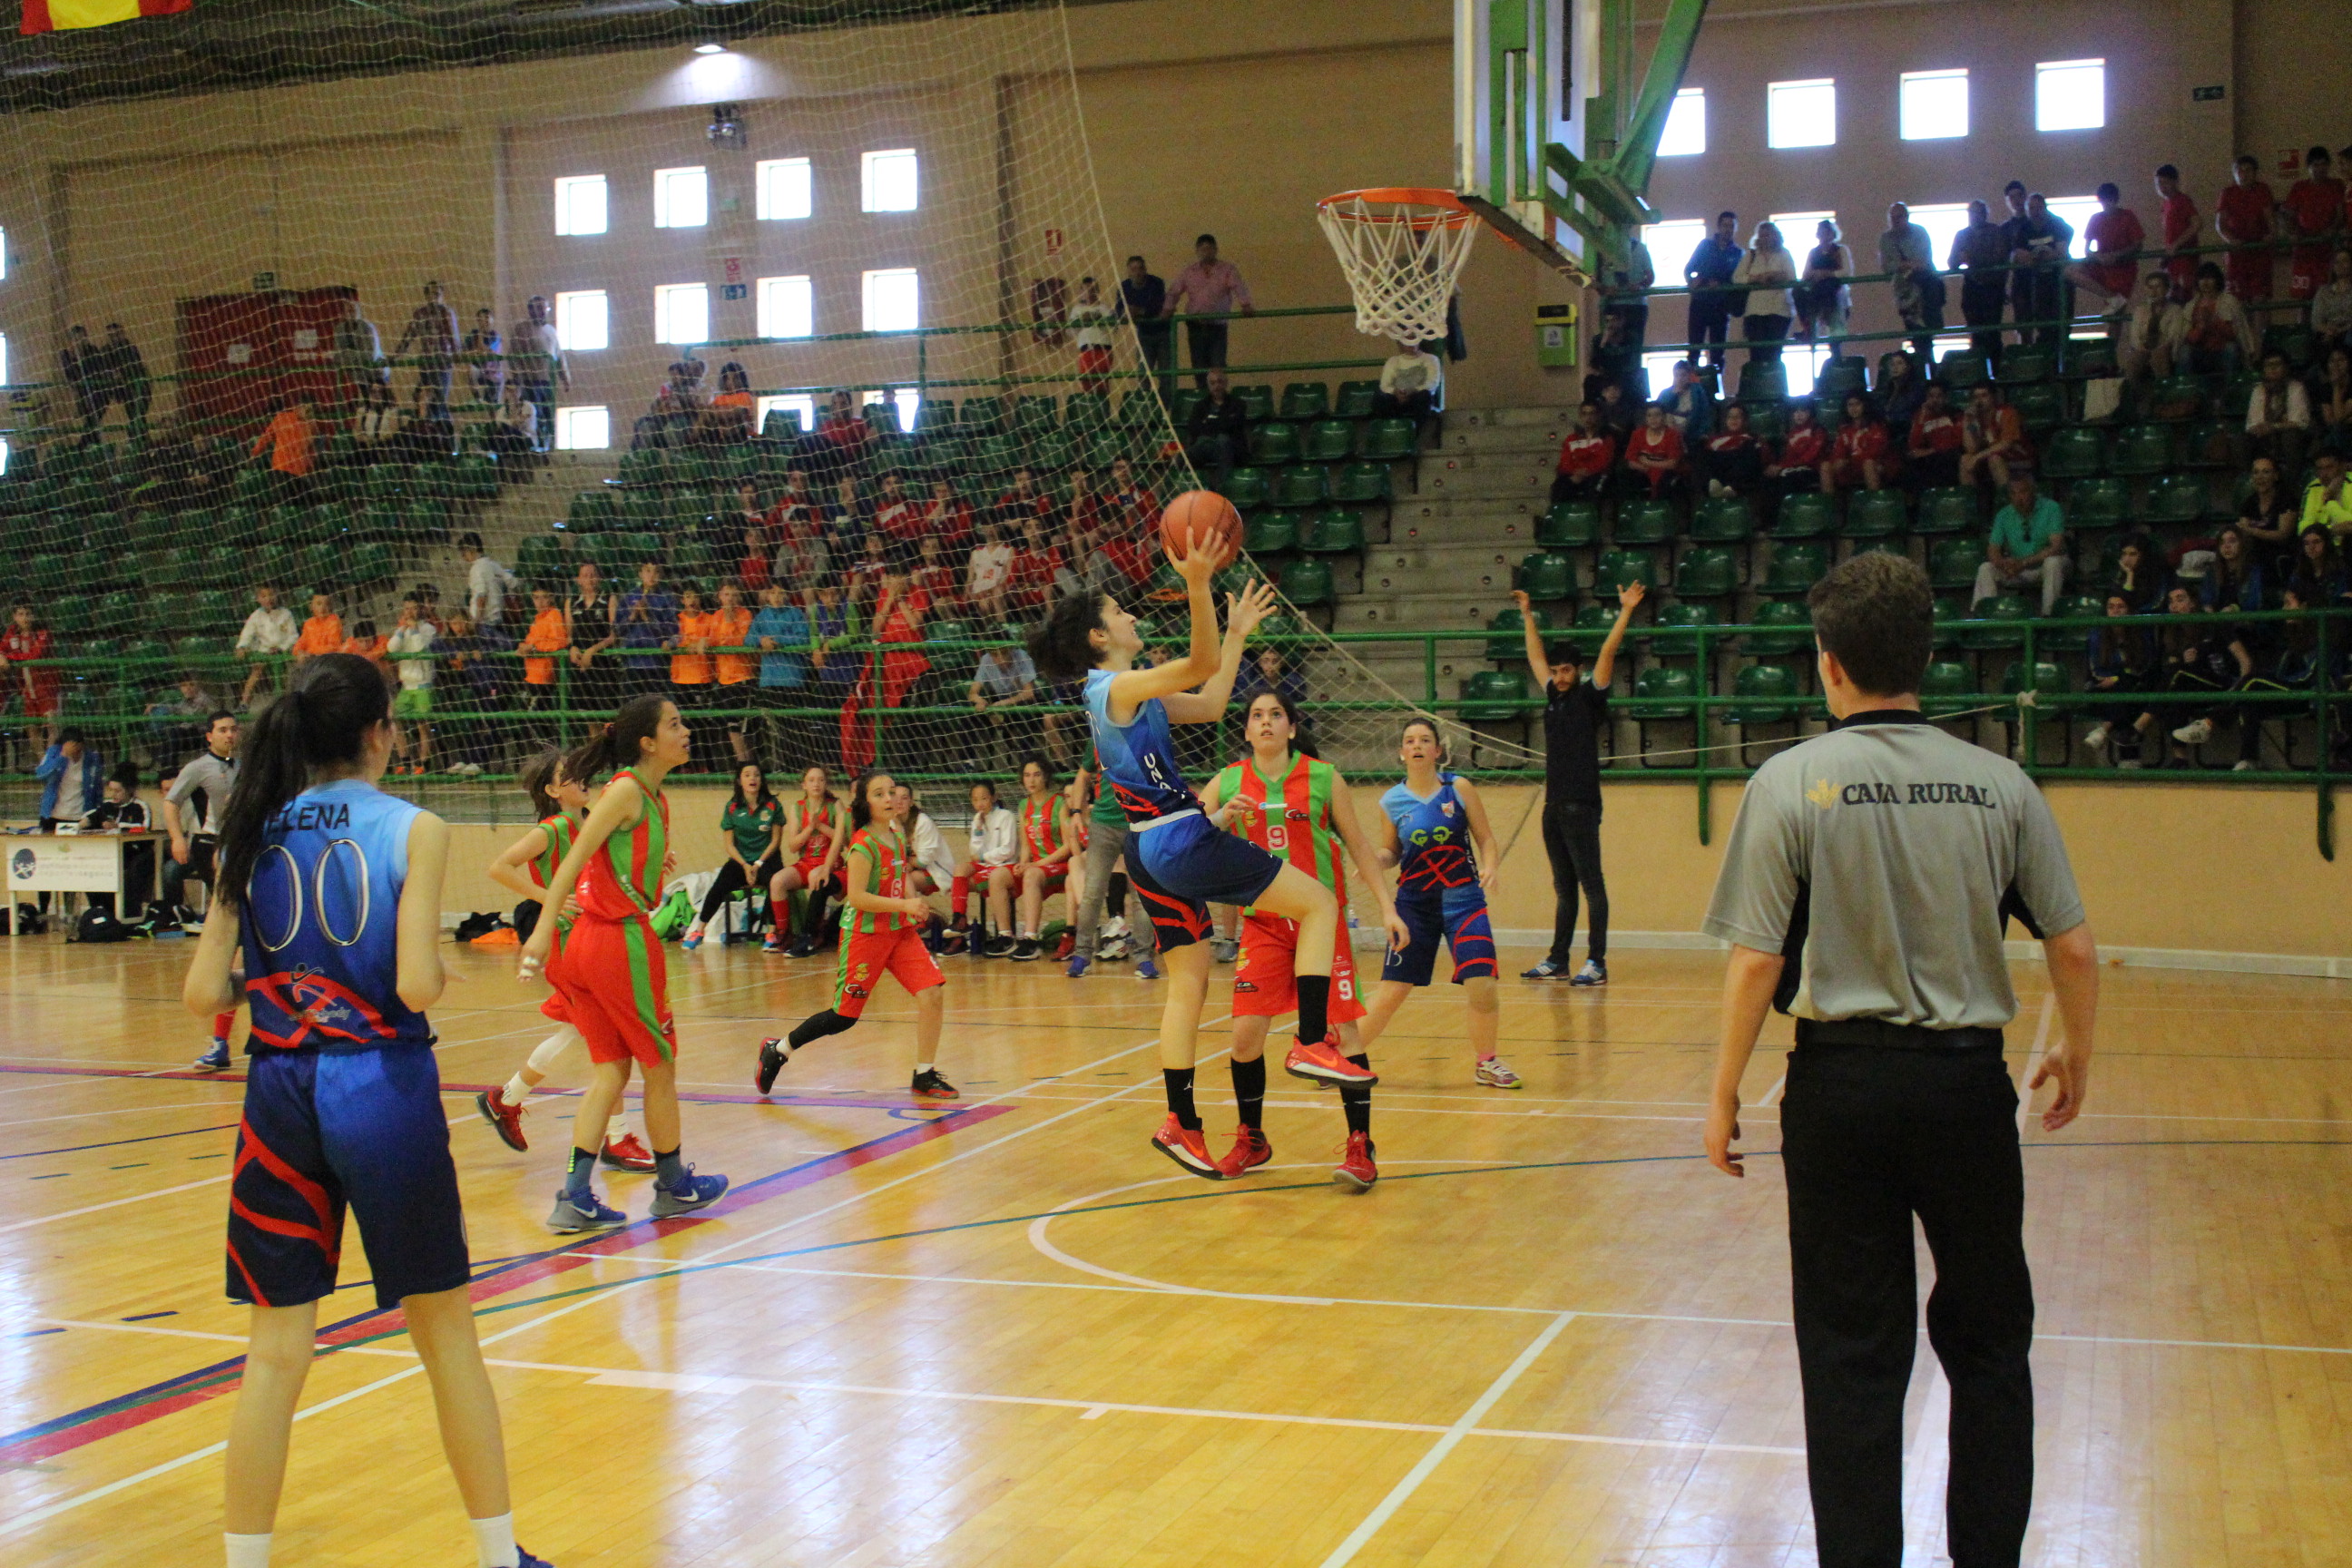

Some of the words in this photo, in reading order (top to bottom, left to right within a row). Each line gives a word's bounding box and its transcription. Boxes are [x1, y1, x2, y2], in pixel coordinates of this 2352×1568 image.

[1842, 782, 1901, 806] CAJA
[1907, 782, 1996, 809] RURAL
[1267, 825, 1289, 850] 9
[1338, 979, 1353, 1000] 9
